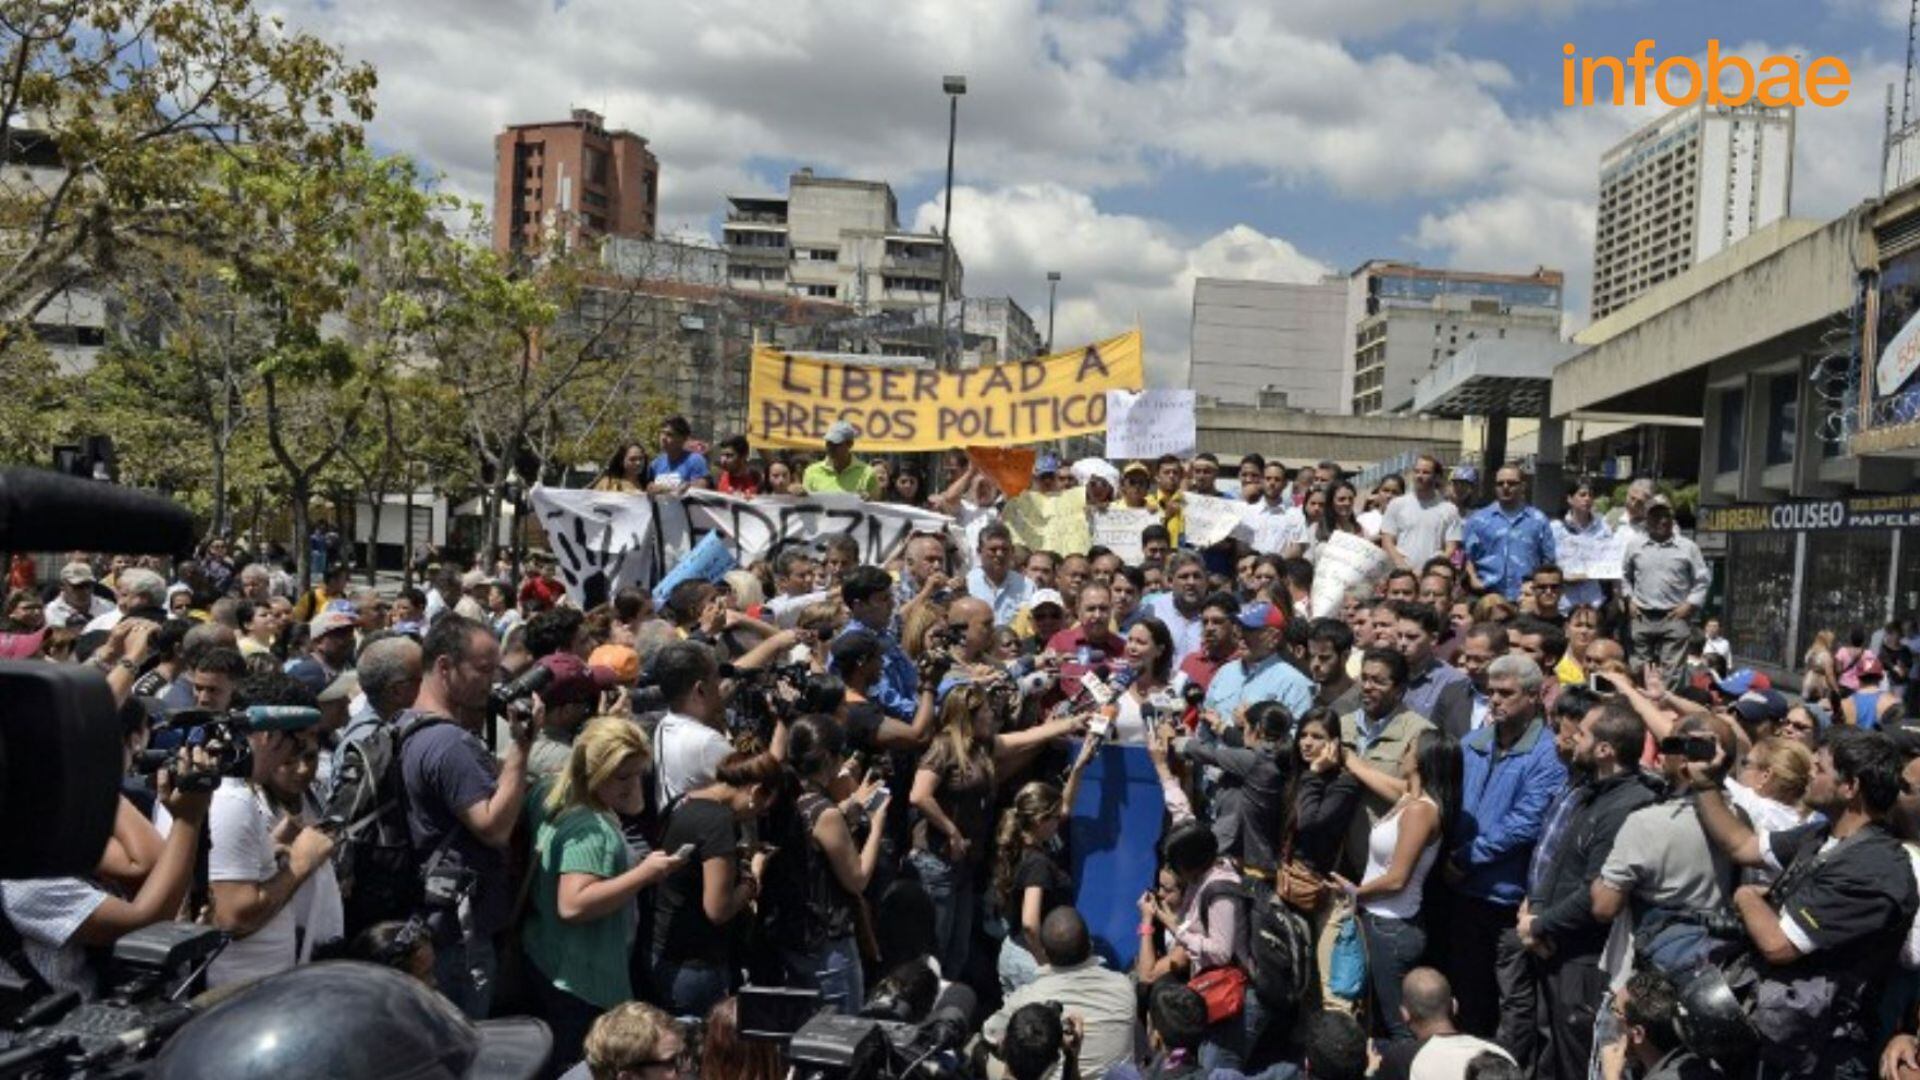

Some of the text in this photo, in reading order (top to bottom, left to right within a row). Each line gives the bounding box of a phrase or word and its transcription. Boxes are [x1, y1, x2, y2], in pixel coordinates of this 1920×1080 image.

[782, 344, 1109, 402] LIBERTAD A
[761, 400, 917, 440] PRESOS
[938, 393, 1109, 441] POLITICO
[1708, 507, 1769, 531] LIBRERIA
[1772, 502, 1844, 529] COLISEO
